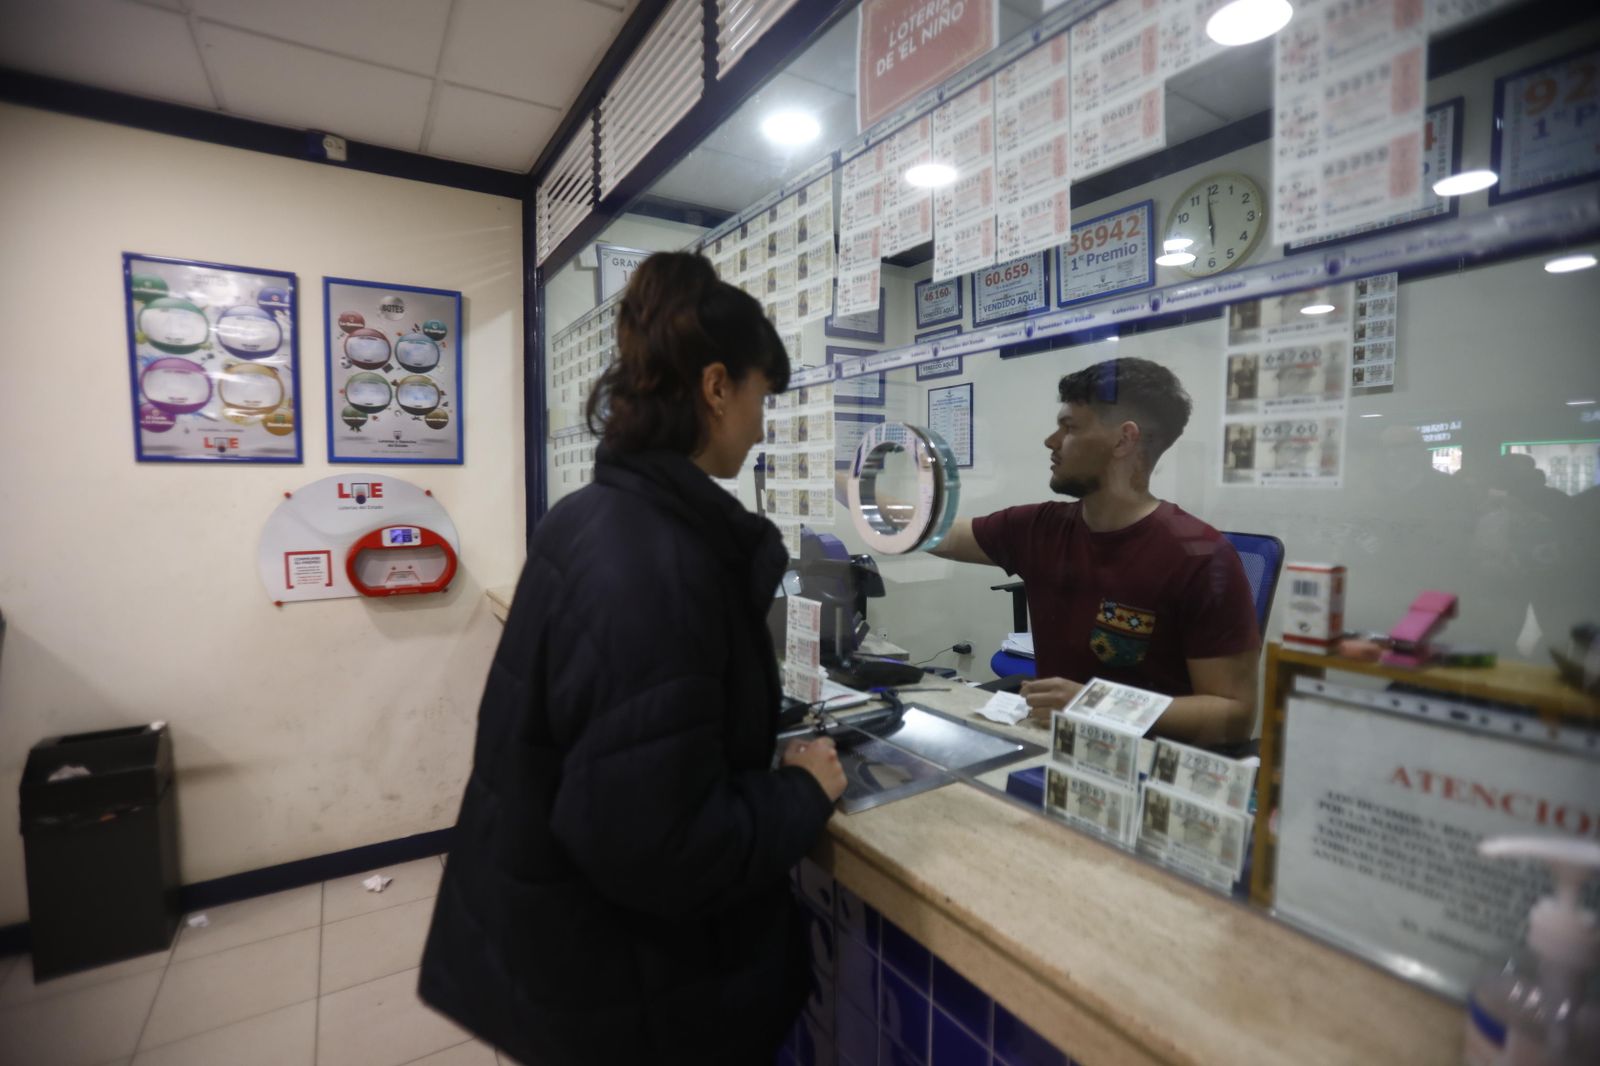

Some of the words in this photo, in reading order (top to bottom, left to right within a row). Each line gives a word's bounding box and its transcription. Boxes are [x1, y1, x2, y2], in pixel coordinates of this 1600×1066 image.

[877, 51, 894, 77] DE
[1208, 184, 1219, 196] 12
[1229, 185, 1234, 195] 1
[1191, 195, 1200, 207] 11
[1242, 193, 1250, 204] 2
[1178, 213, 1190, 224] 10
[1247, 211, 1256, 222] 3
[1067, 214, 1141, 257] 36942
[1240, 231, 1248, 241] 4
[1086, 242, 1138, 267] Premio
[1226, 248, 1234, 259] 5
[1208, 257, 1216, 268] 6
[985, 262, 1029, 287] 60.659
[983, 298, 1016, 313] VENDIDO
[1390, 765, 1600, 836] ATENCIO
